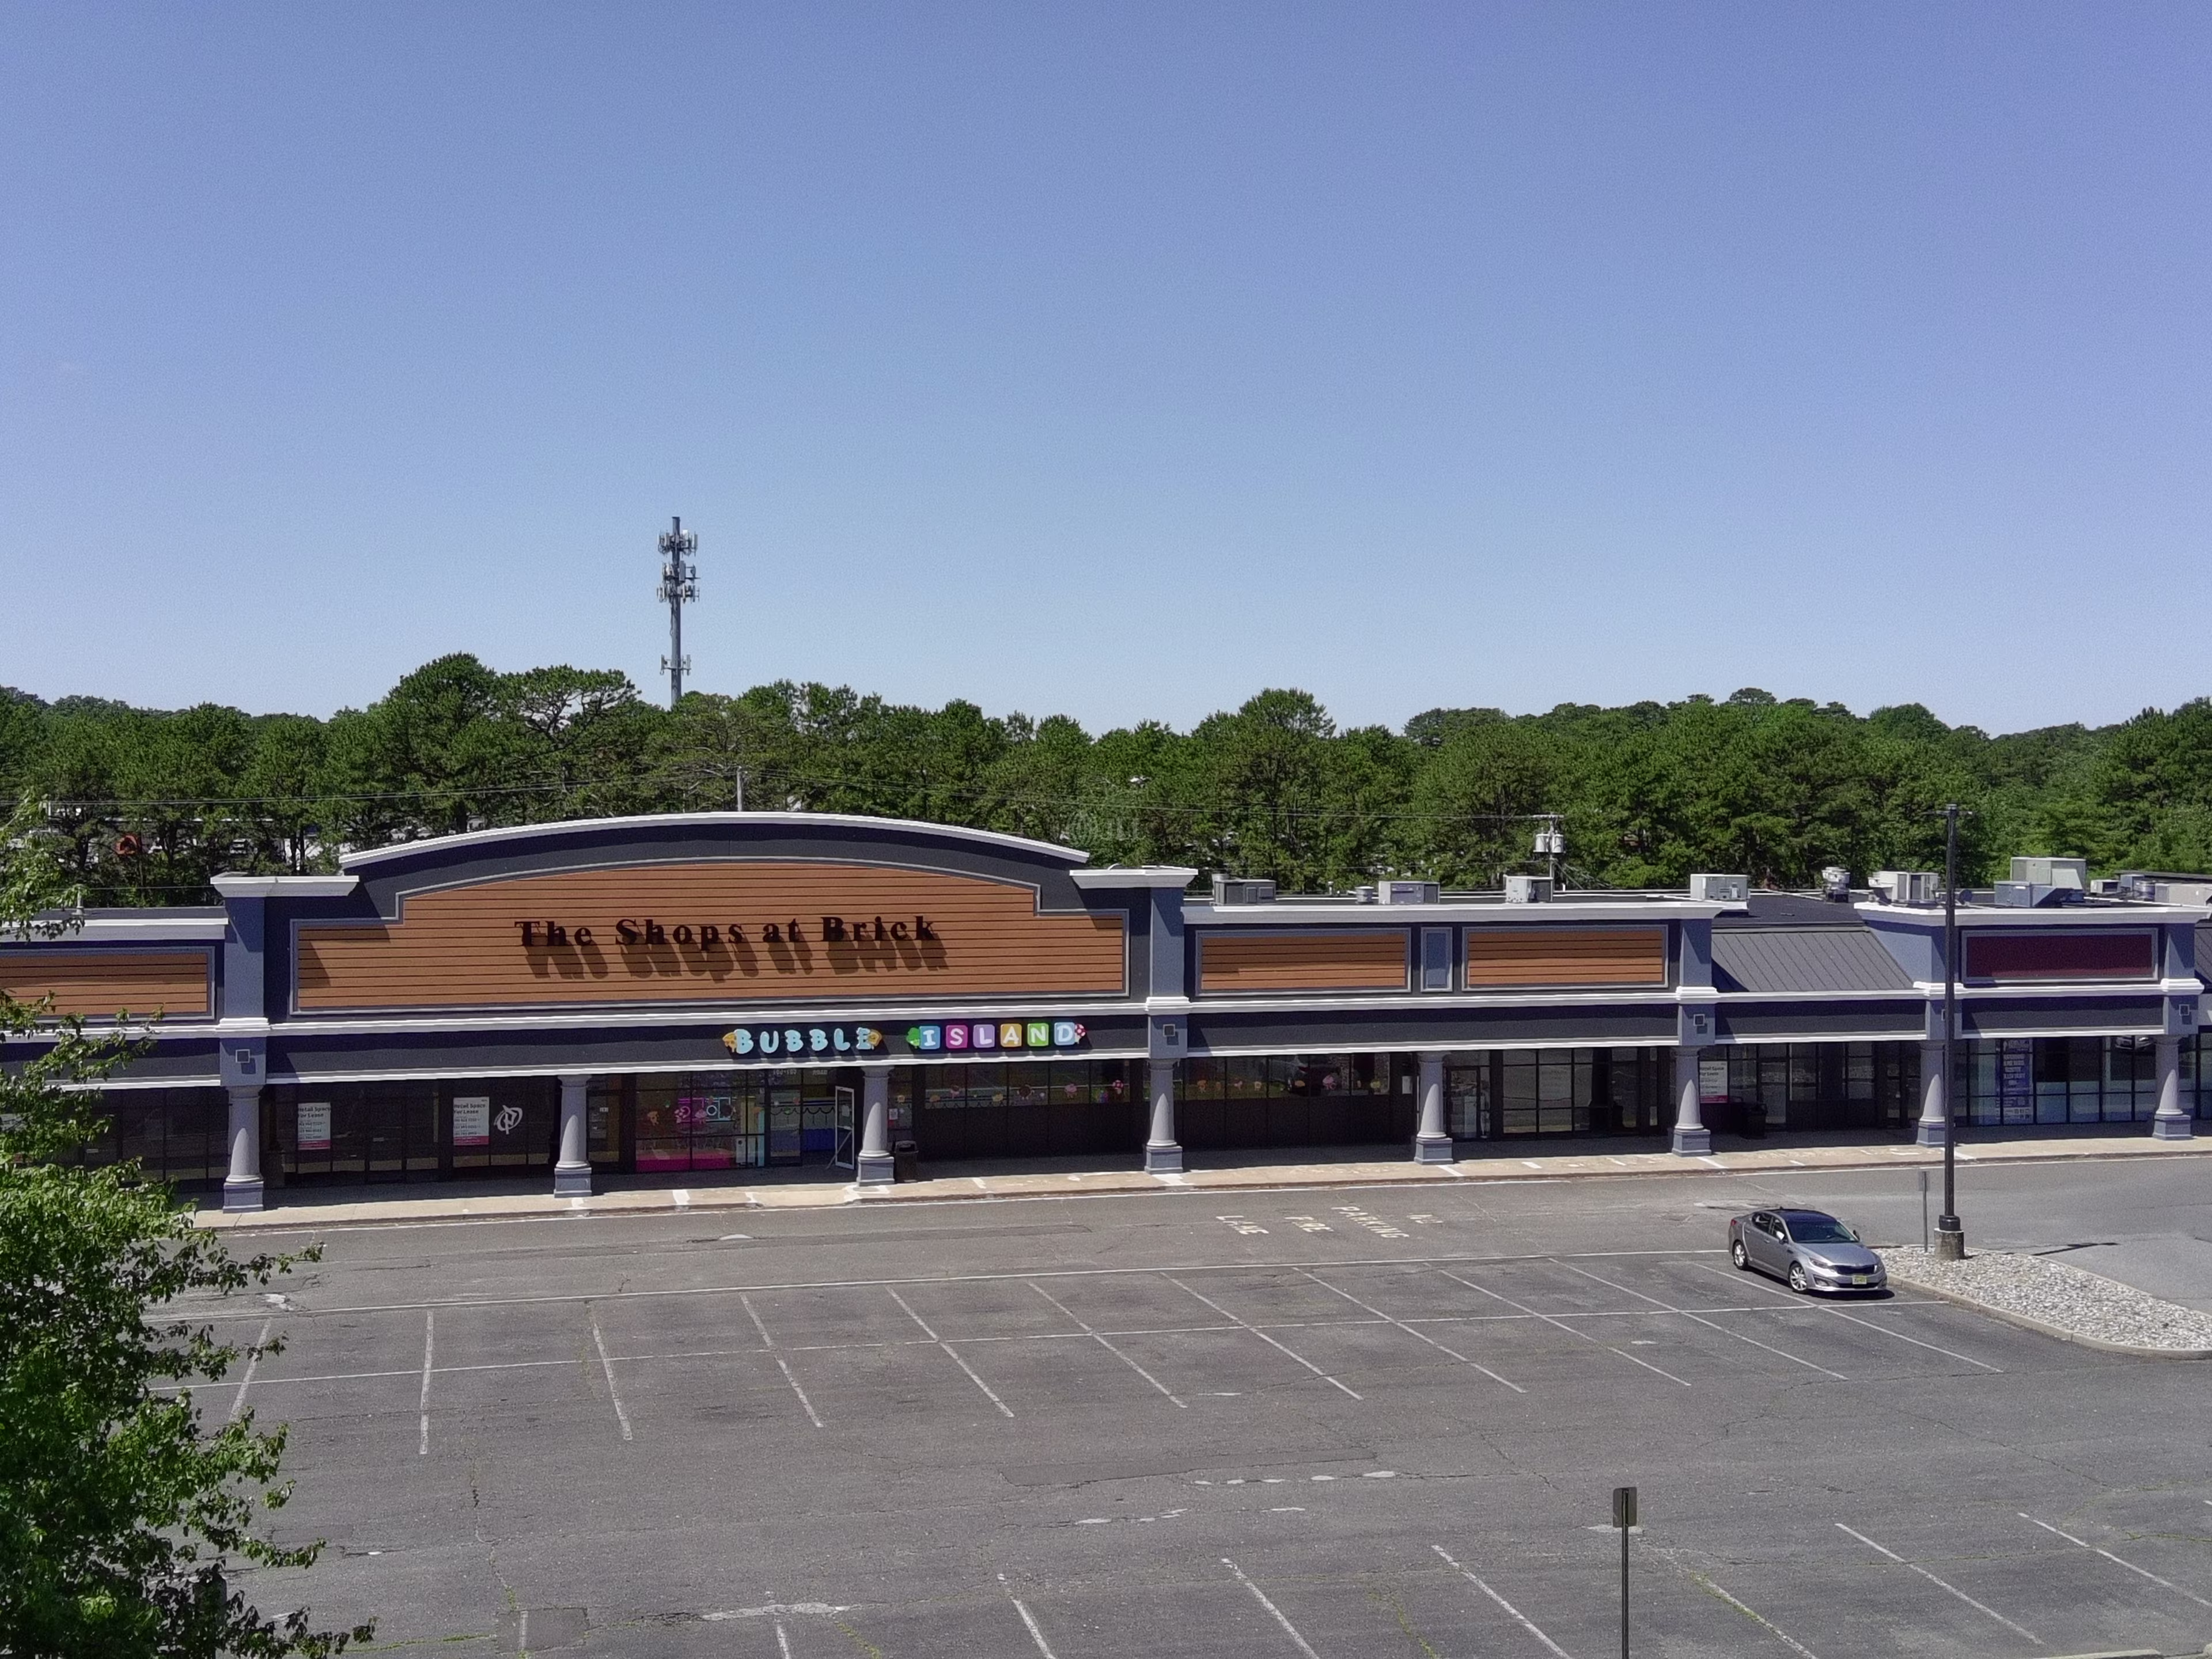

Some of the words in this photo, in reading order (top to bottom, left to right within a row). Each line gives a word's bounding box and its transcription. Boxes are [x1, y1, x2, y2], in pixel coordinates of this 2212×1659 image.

[514, 920, 592, 947] The
[615, 918, 743, 951] Shops
[762, 916, 799, 943] at
[820, 914, 935, 942] Brick
[734, 1027, 876, 1054] BUBBLE
[922, 1024, 1075, 1048] ISLAND
[1215, 1215, 1270, 1235] LANE
[1331, 1206, 1410, 1238] PARKING
